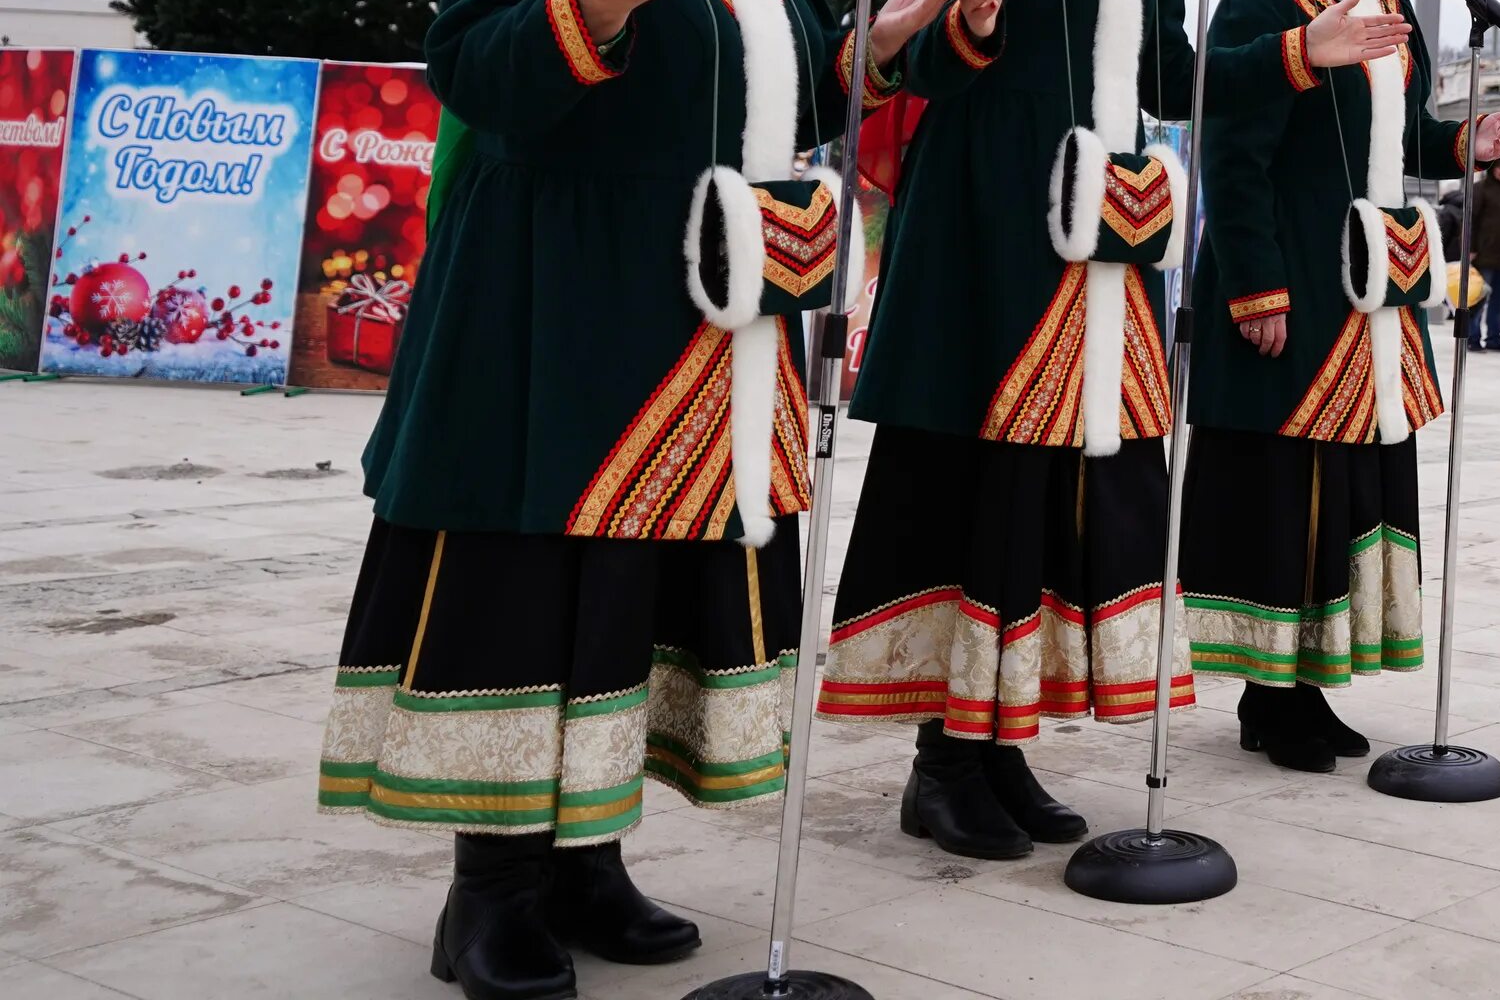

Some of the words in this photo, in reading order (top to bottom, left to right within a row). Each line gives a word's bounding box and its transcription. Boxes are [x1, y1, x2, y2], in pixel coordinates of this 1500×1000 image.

[0, 115, 63, 143] ством!
[98, 94, 132, 138] С
[134, 96, 285, 146] Новым
[322, 130, 345, 159] С
[115, 145, 262, 204] Годом!
[820, 413, 834, 453] On-Stage
